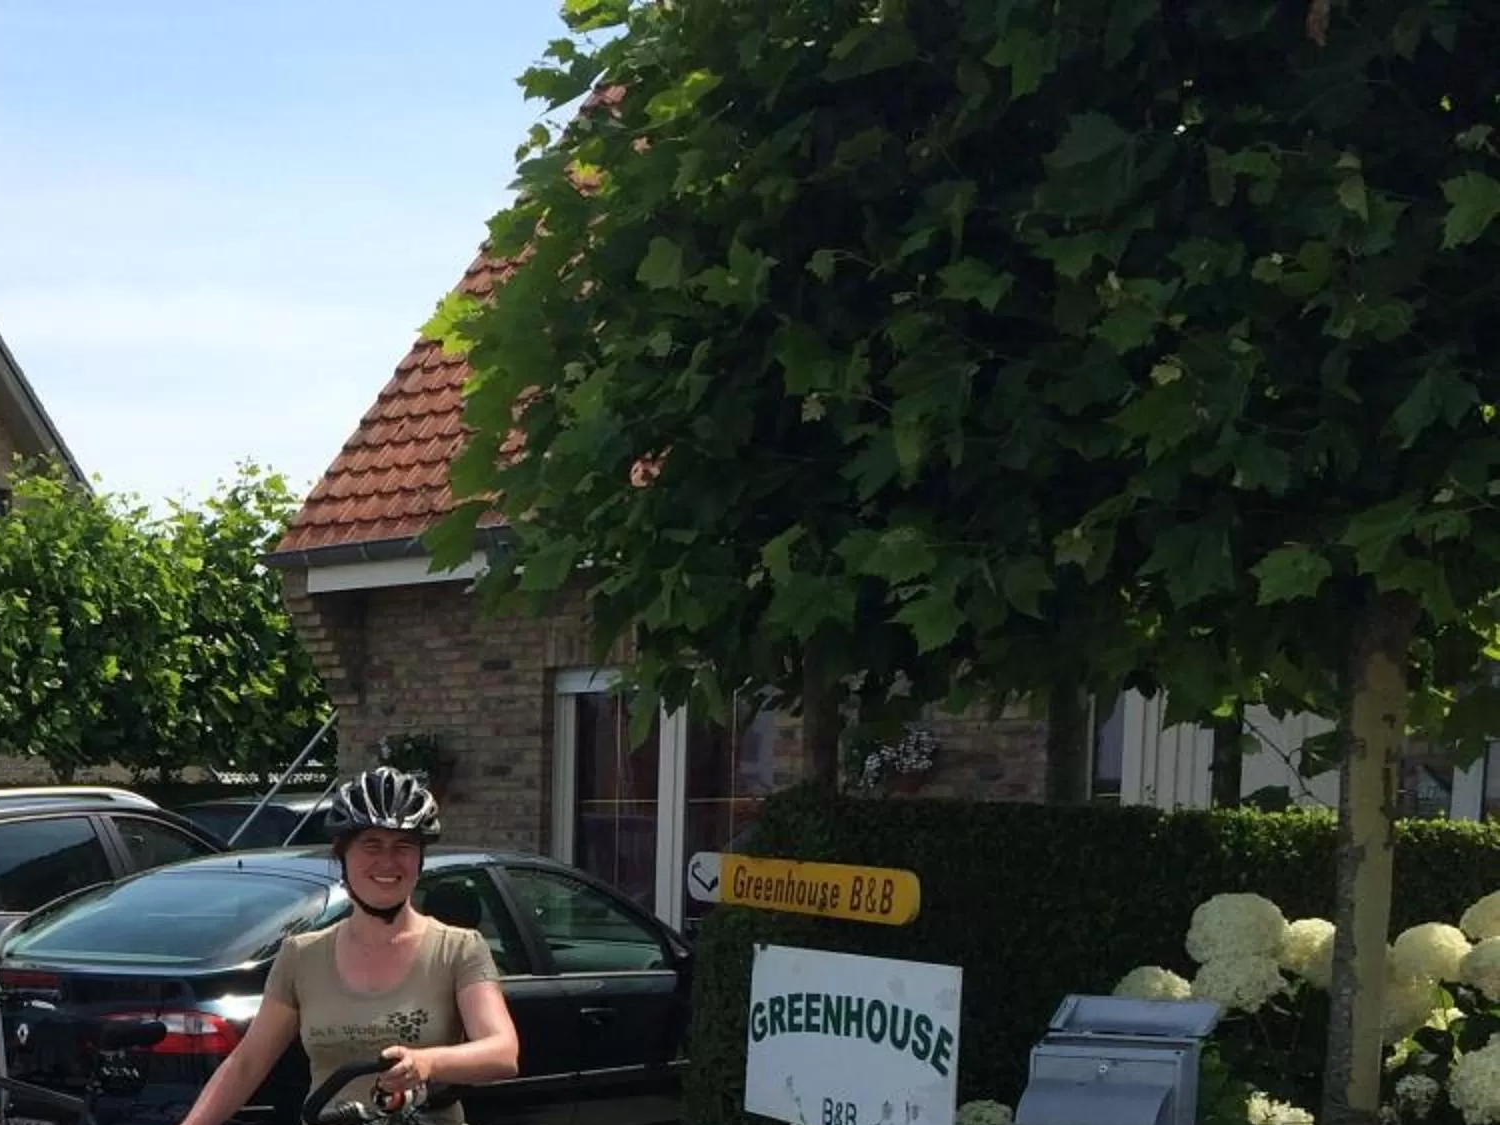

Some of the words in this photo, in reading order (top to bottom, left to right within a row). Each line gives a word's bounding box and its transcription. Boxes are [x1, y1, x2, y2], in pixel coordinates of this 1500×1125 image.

[733, 865, 840, 909] Greenhouse
[850, 875, 894, 915] B&B
[751, 993, 953, 1077] GREENHOUSE
